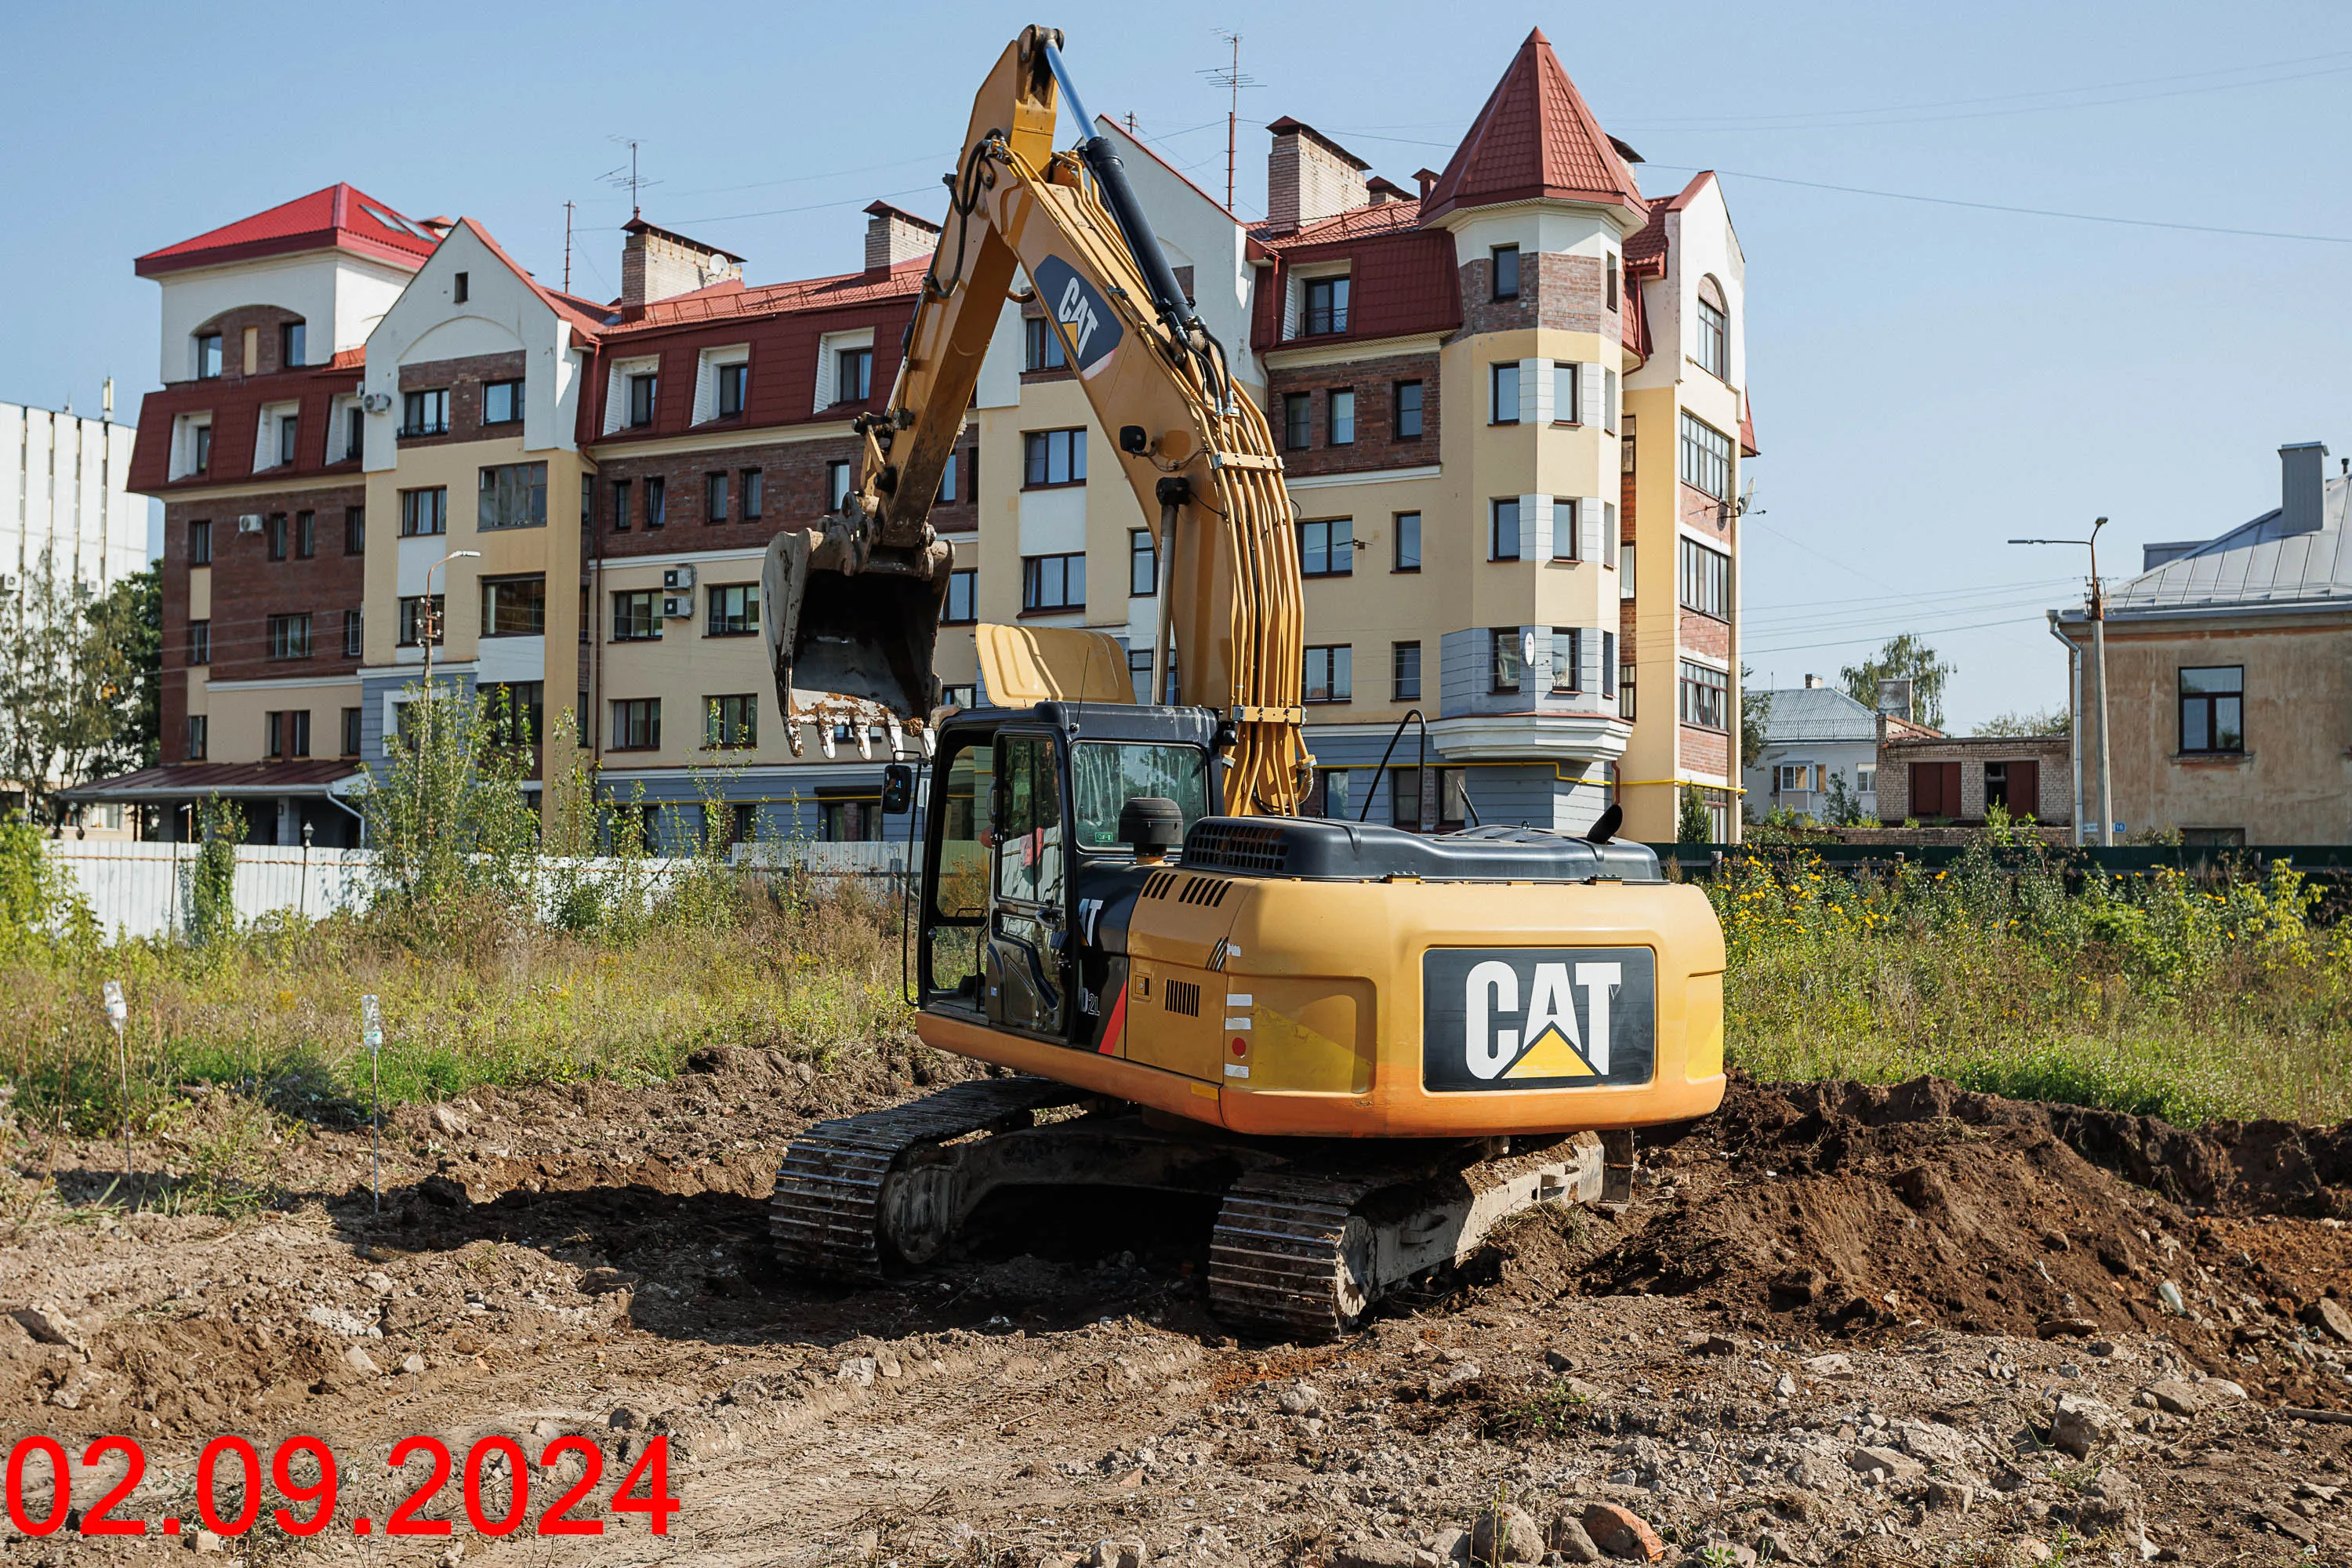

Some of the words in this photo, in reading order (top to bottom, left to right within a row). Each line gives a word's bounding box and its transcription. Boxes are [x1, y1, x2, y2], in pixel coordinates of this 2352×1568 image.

[1058, 277, 1098, 359] CAT
[1079, 898, 1104, 946] AT
[1465, 960, 1622, 1080] CAT
